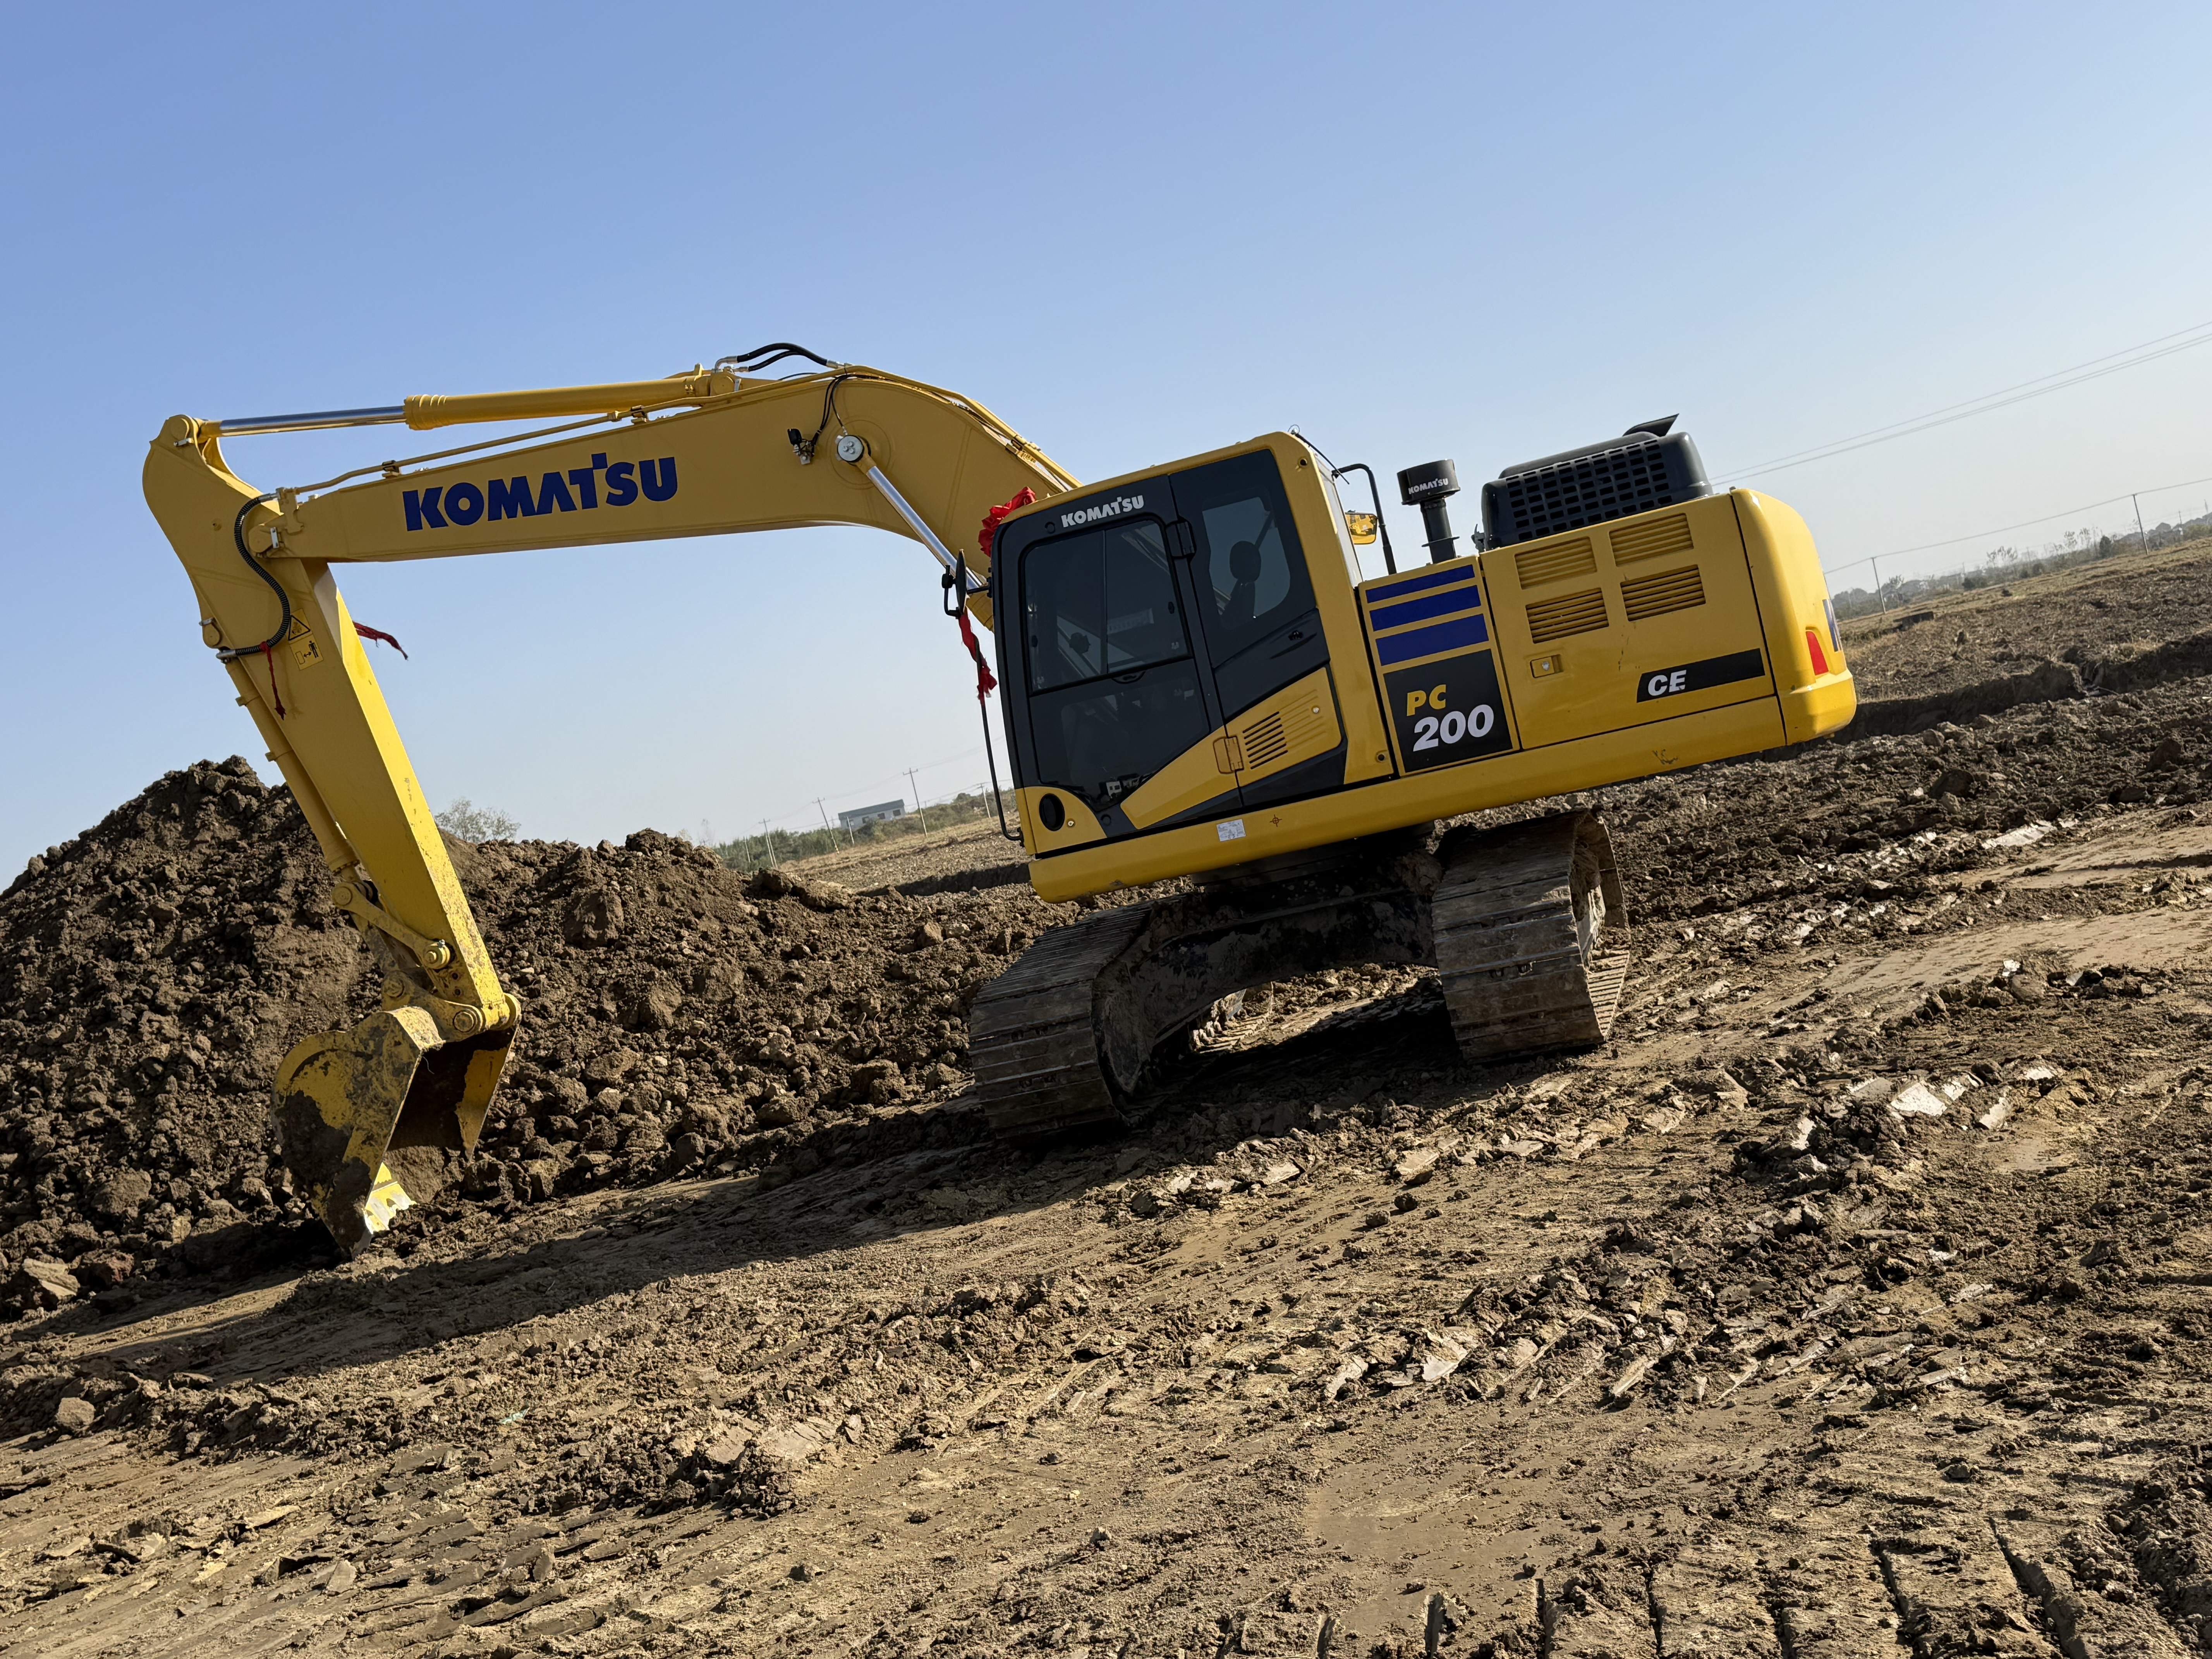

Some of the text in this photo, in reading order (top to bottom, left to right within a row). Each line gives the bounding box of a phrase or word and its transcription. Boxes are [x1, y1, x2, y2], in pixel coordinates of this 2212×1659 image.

[402, 452, 678, 531] KOMATSU
[1408, 478, 1449, 495] KOMATSU
[1061, 495, 1144, 527] KOMATSU
[1648, 670, 1686, 696] CE
[1407, 684, 1446, 716] PC
[1413, 704, 1494, 752] 200
